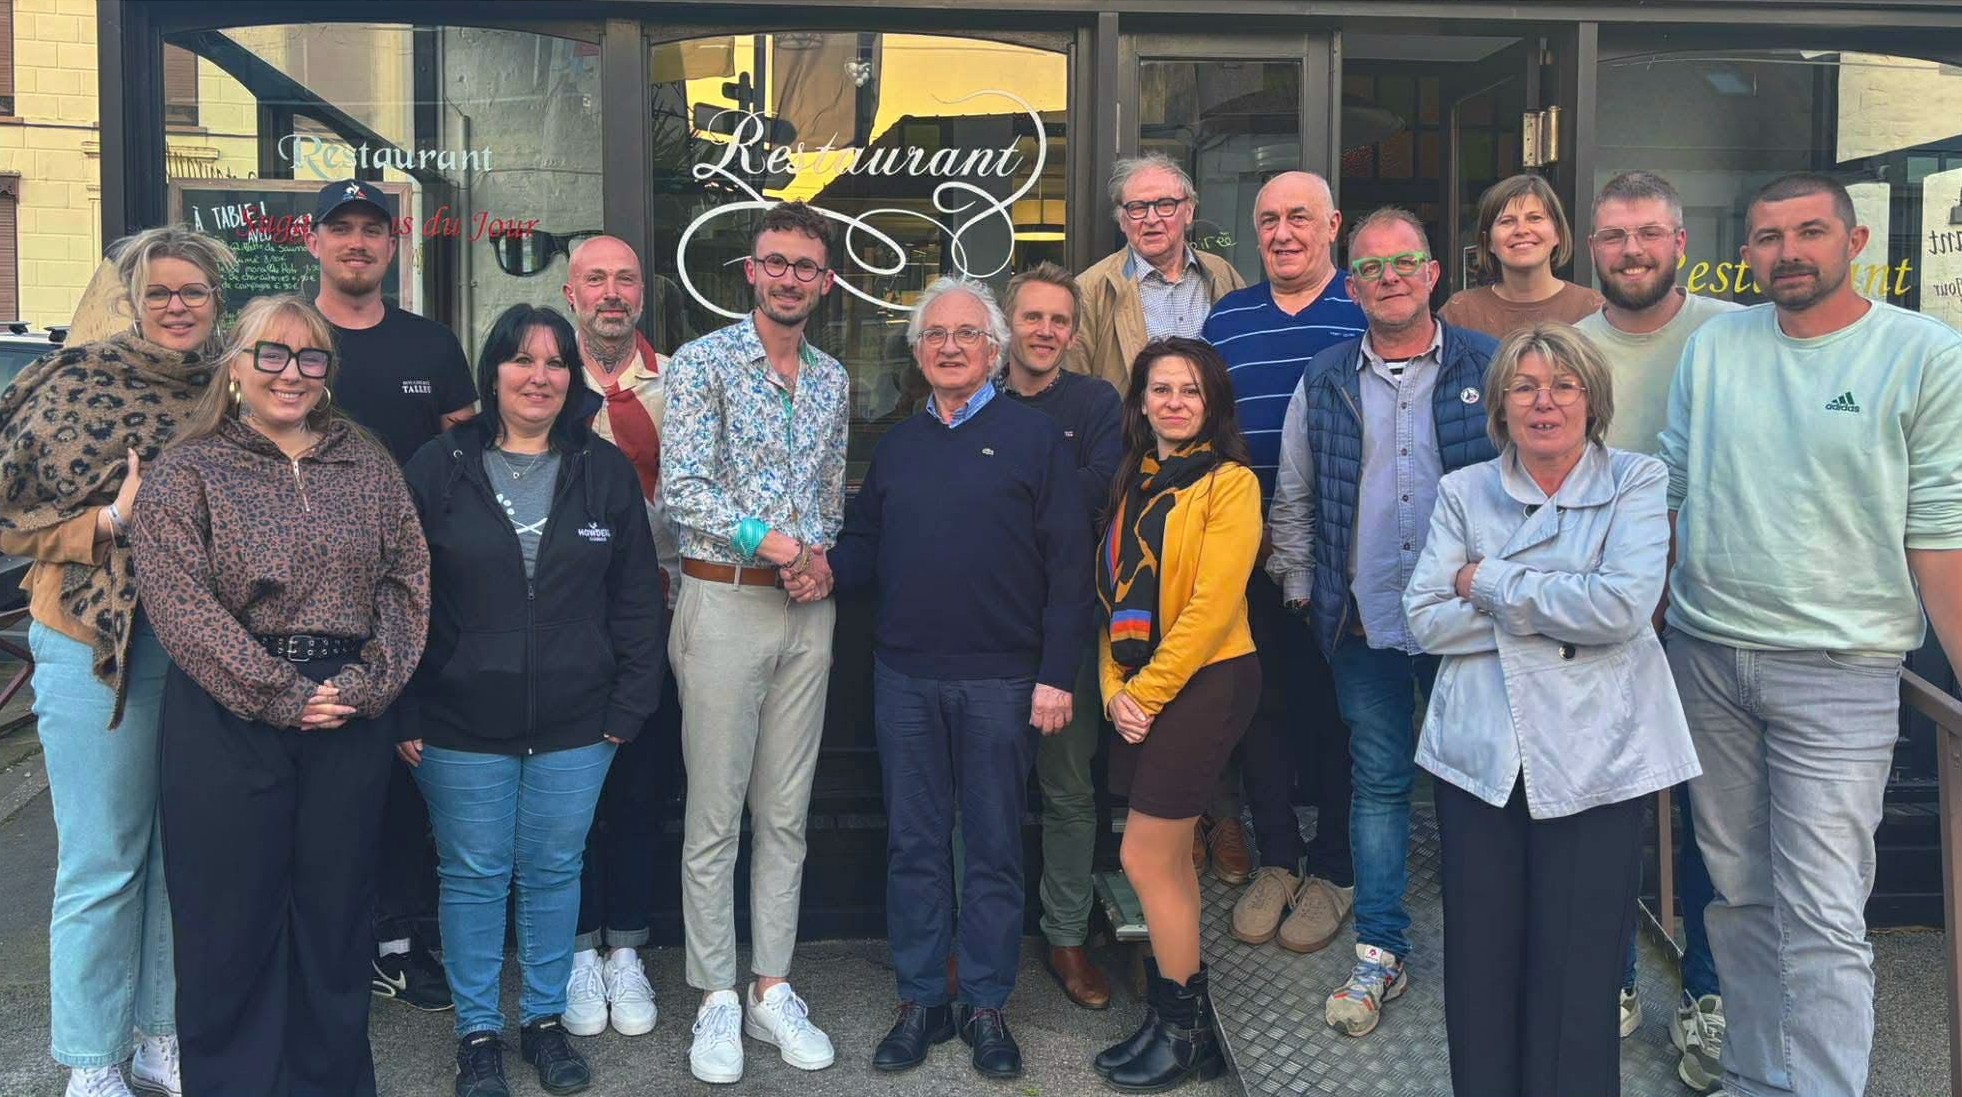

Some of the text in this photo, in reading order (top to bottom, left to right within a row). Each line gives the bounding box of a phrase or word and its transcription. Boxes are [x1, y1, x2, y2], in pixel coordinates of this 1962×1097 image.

[278, 134, 493, 180] Restaurant
[693, 108, 1024, 178] Restaurant
[192, 205, 204, 232] À
[211, 202, 257, 230] TABLE
[423, 205, 461, 239] du
[466, 211, 540, 242] Jour
[1825, 403, 1860, 413] adidas
